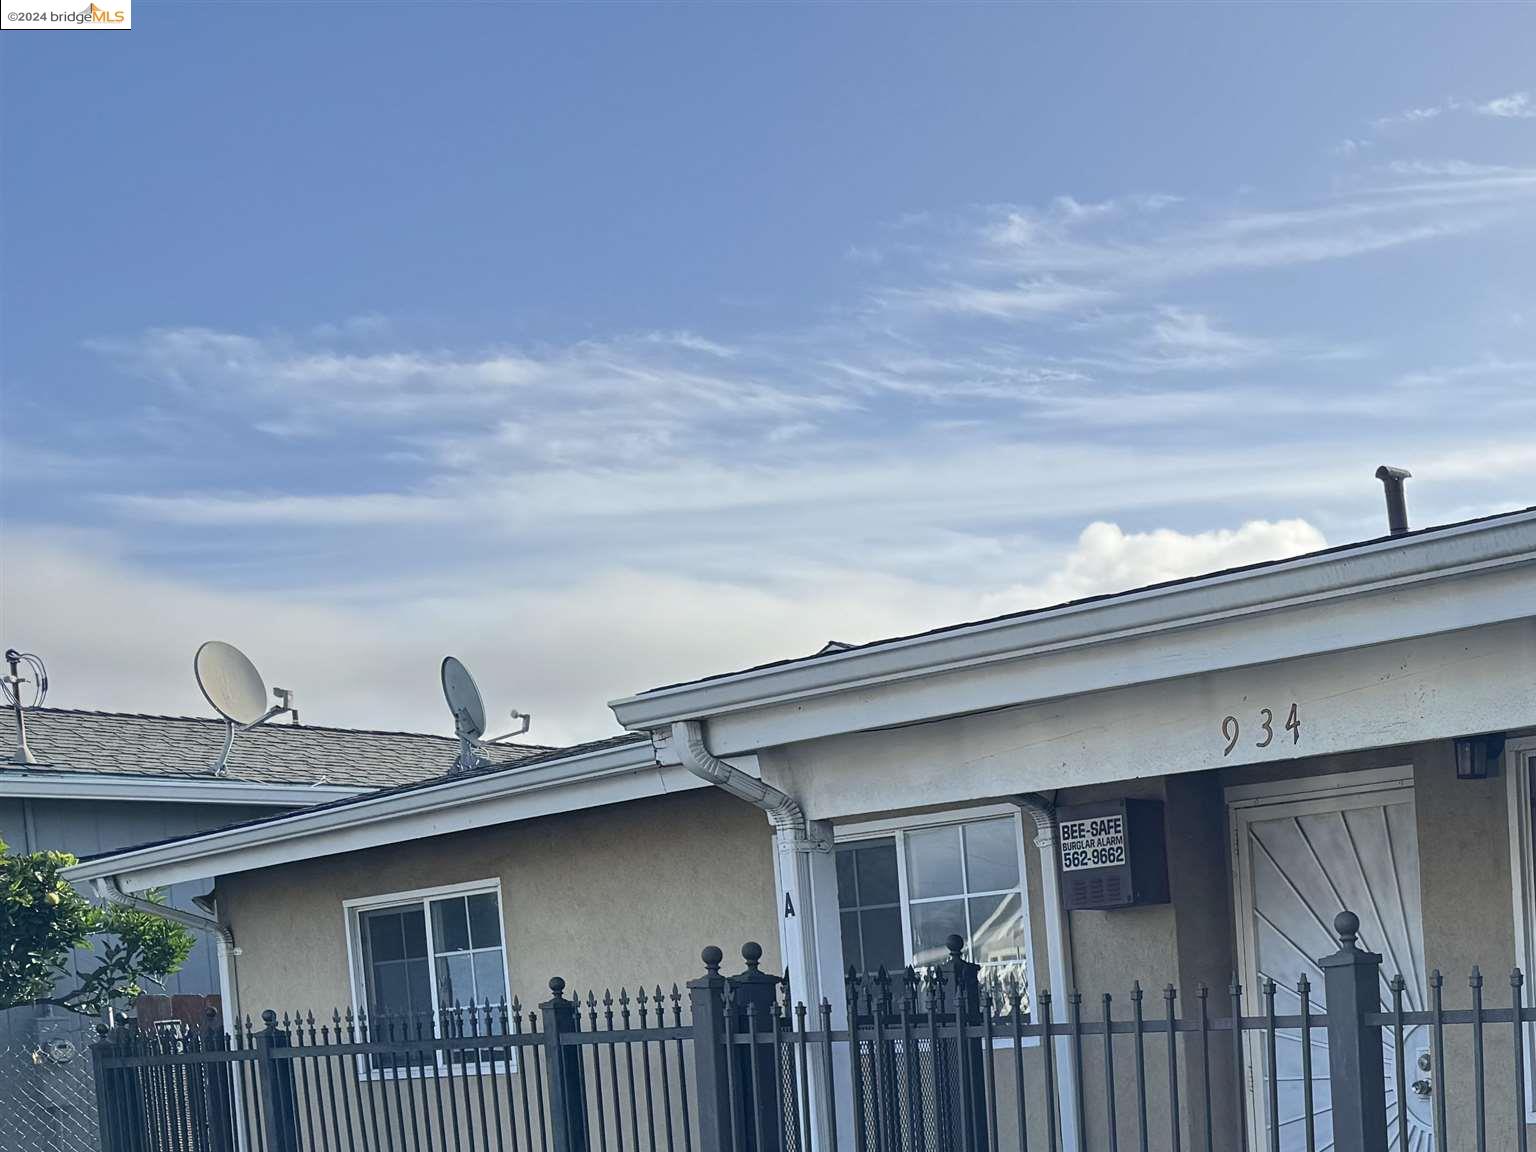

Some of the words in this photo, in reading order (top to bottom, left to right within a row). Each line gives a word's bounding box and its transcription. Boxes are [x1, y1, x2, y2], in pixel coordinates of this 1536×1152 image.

[1222, 703, 1301, 757] 934
[1061, 818, 1122, 841] BEE-SAFE
[1062, 839, 1096, 852] BURGLAR
[1096, 836, 1123, 848] ALARM
[1063, 846, 1124, 868] 562-9662
[784, 892, 796, 918] A
